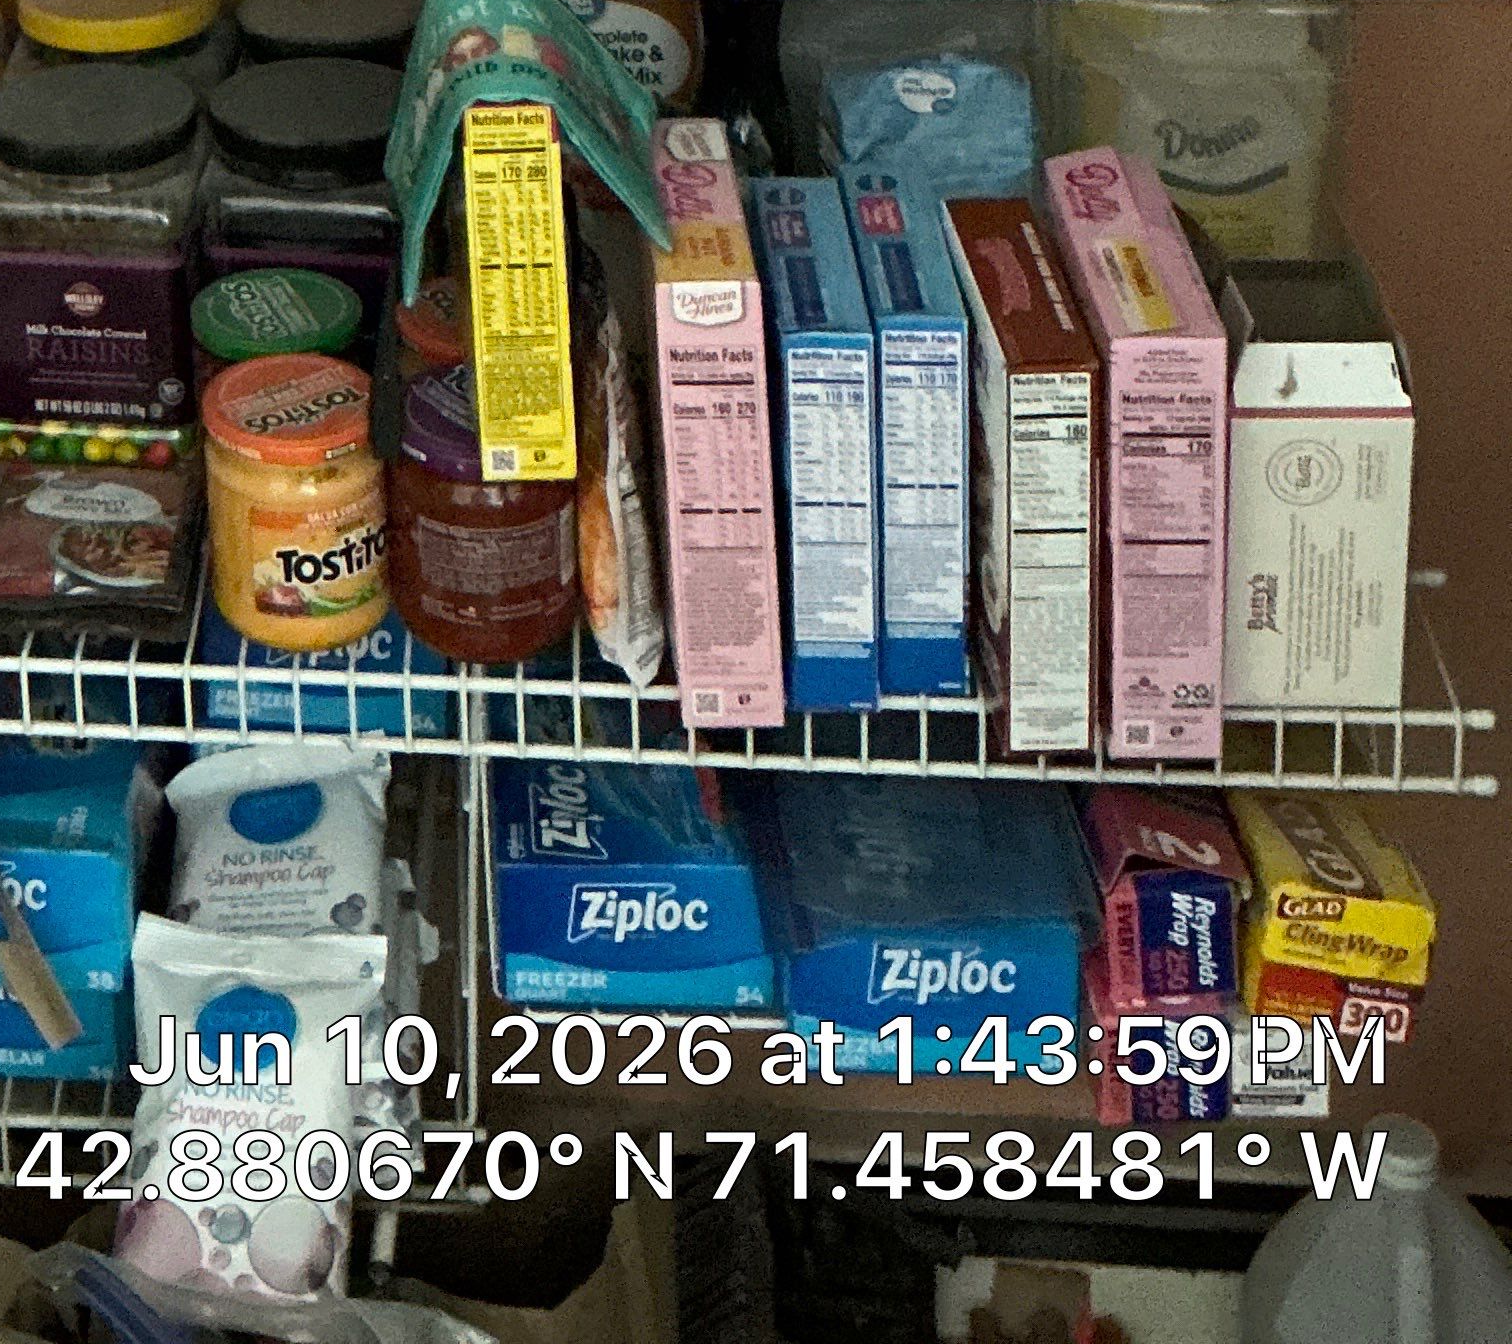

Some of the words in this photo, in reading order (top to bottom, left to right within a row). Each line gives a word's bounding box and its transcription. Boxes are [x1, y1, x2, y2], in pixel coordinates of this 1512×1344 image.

[472, 114, 514, 127] Nutrition
[518, 114, 545, 126] Facts
[676, 291, 737, 308] Duncan
[26, 324, 48, 336] Milk
[51, 325, 102, 339] Chocolate
[26, 336, 150, 363] RAISINS
[670, 348, 718, 362] Nutrition
[722, 349, 753, 362] Facts
[1013, 374, 1058, 387] Nutrition
[1122, 394, 1175, 407] Nutrition
[1179, 394, 1213, 407] Facts
[1186, 440, 1213, 455] 170
[539, 764, 605, 849] Ziploc
[222, 850, 255, 869] NO
[204, 866, 292, 889] Shampoo
[297, 861, 337, 885] Cap
[580, 888, 709, 943] Ziploc
[1167, 889, 1192, 947] Wrap
[1282, 896, 1343, 919] GLAD
[1191, 895, 1220, 989] Reynolds
[515, 971, 608, 989] FREEZER
[881, 947, 1017, 1006] Ziploc
[167, 1099, 262, 1133] Shampoo
[266, 1109, 306, 1136] Cap
